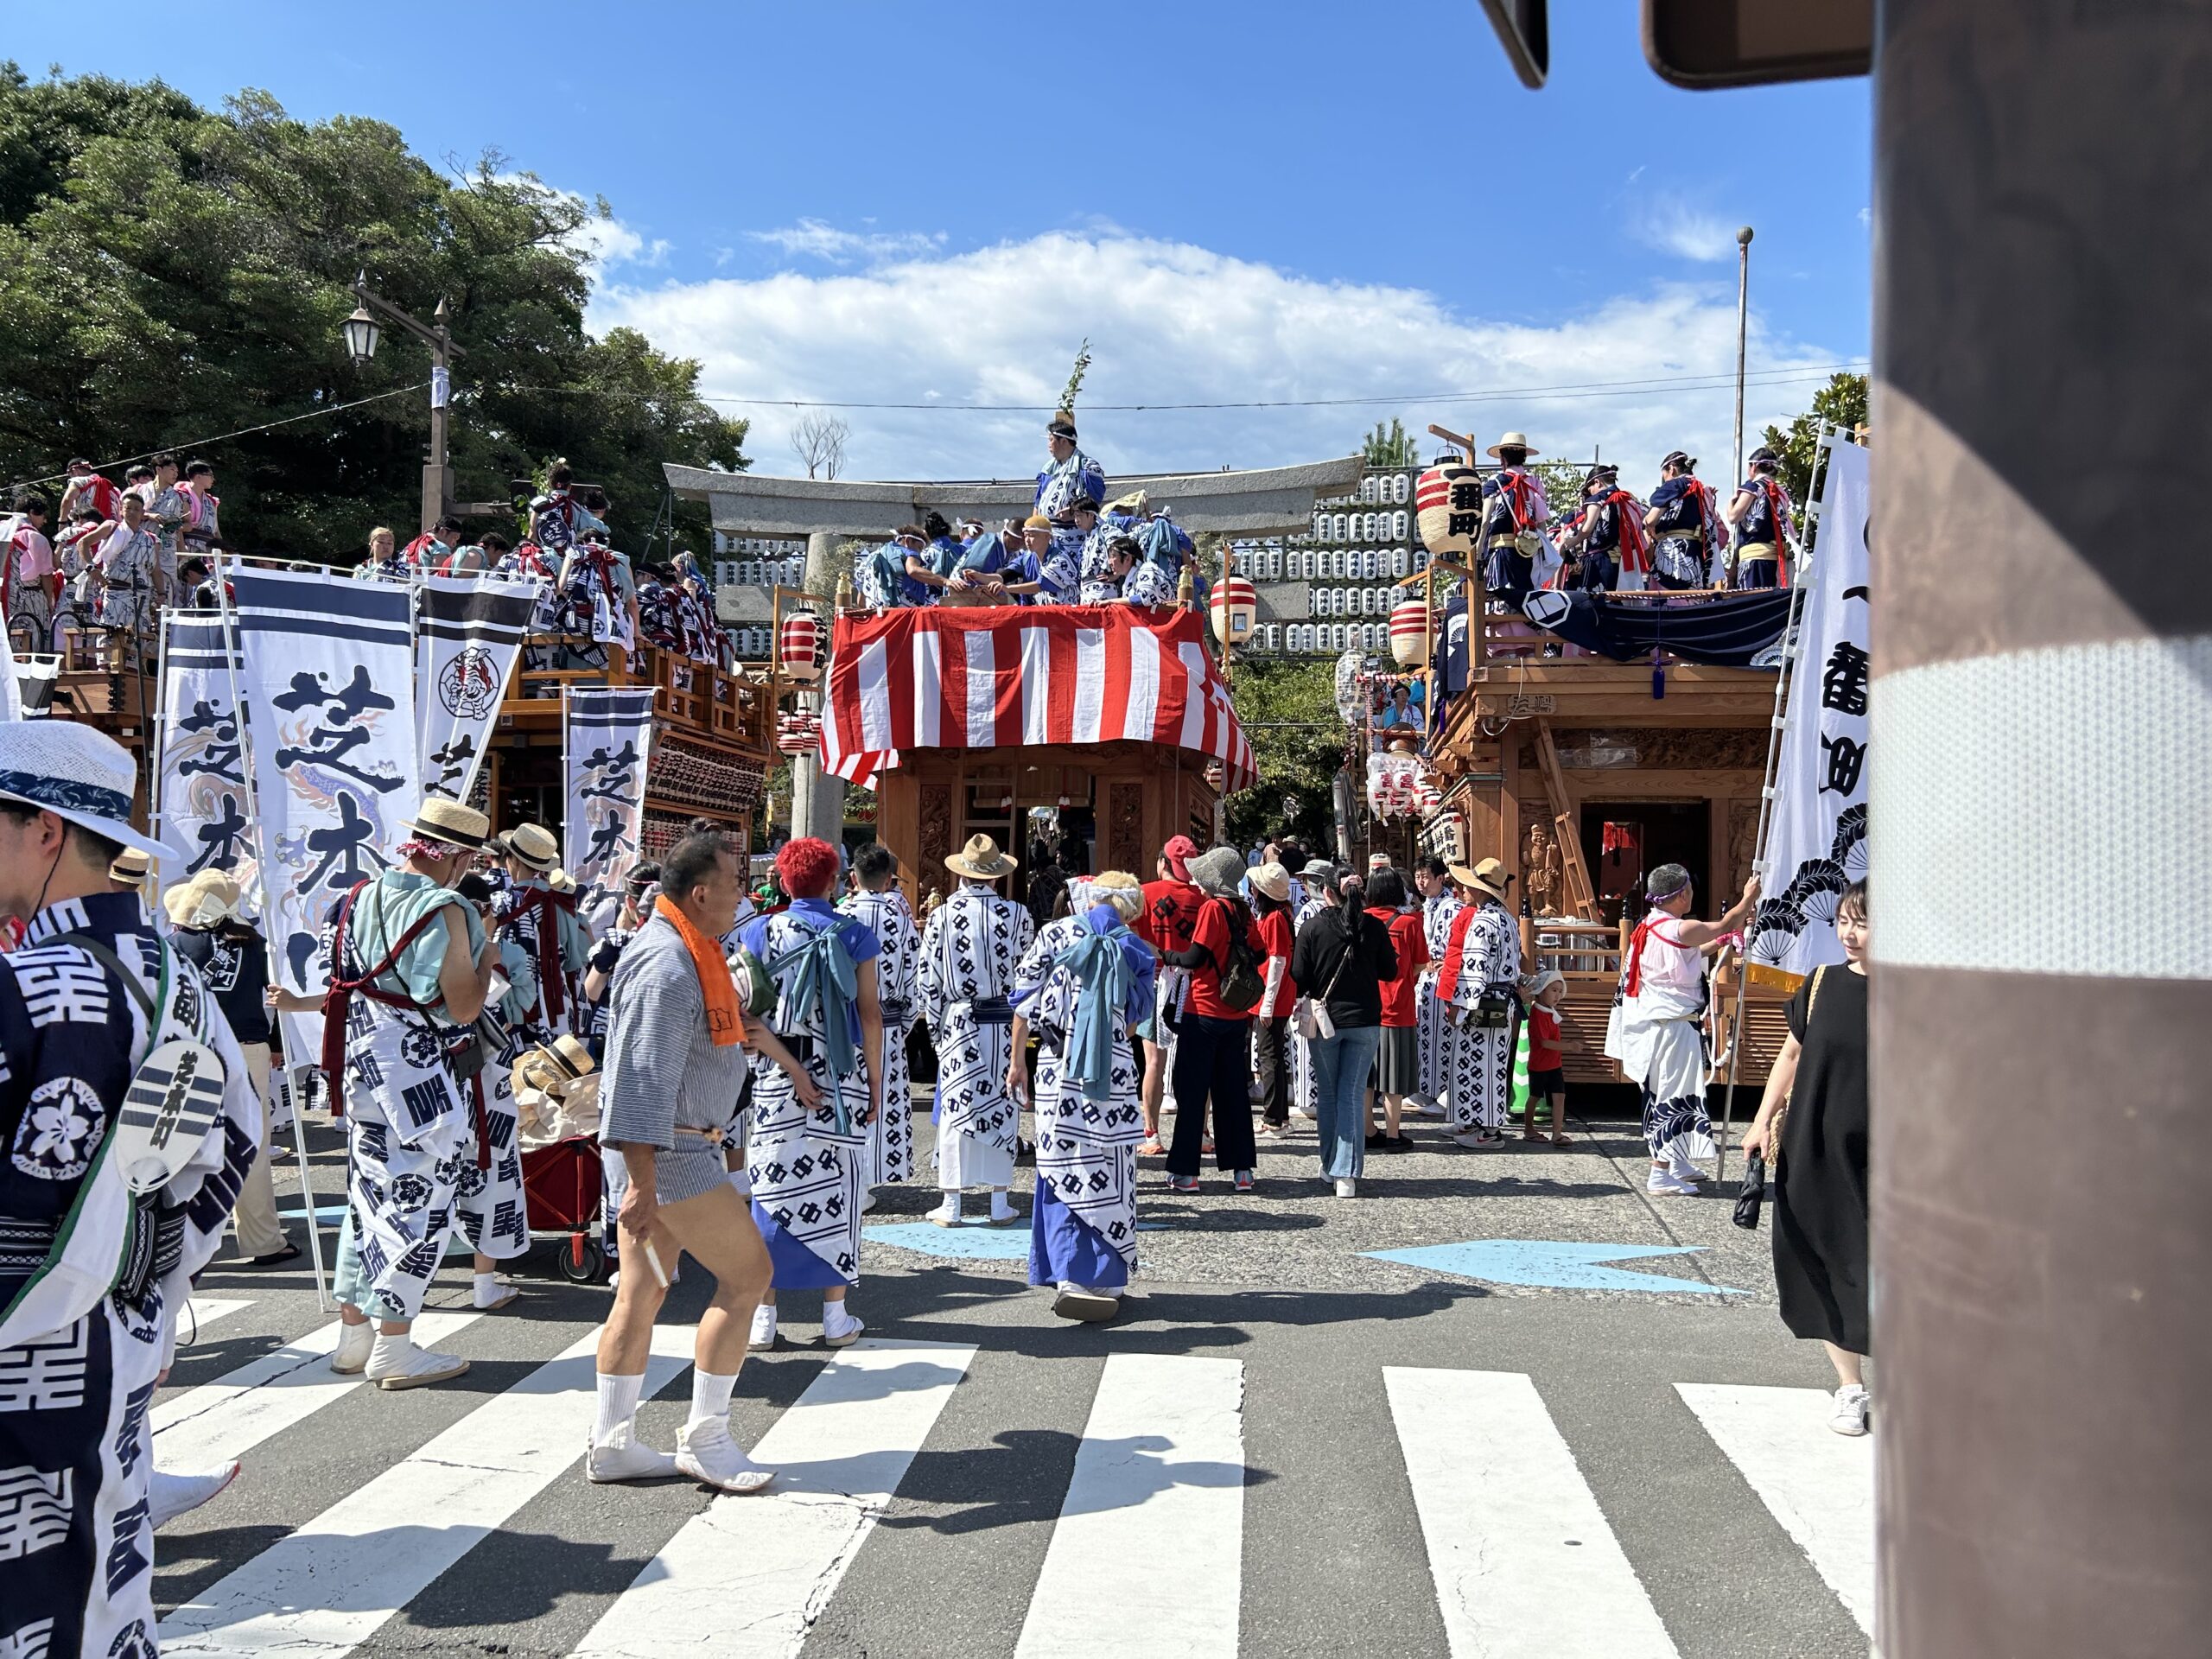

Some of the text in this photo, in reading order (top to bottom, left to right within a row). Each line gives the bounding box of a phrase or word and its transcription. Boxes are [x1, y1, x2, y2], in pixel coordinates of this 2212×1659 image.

[1443, 468, 1483, 545] 一番町
[178, 690, 259, 926] 芝本
[273, 664, 406, 995] 芝本
[1442, 817, 1459, 856] 一番町
[149, 1050, 199, 1151] 芝本町
